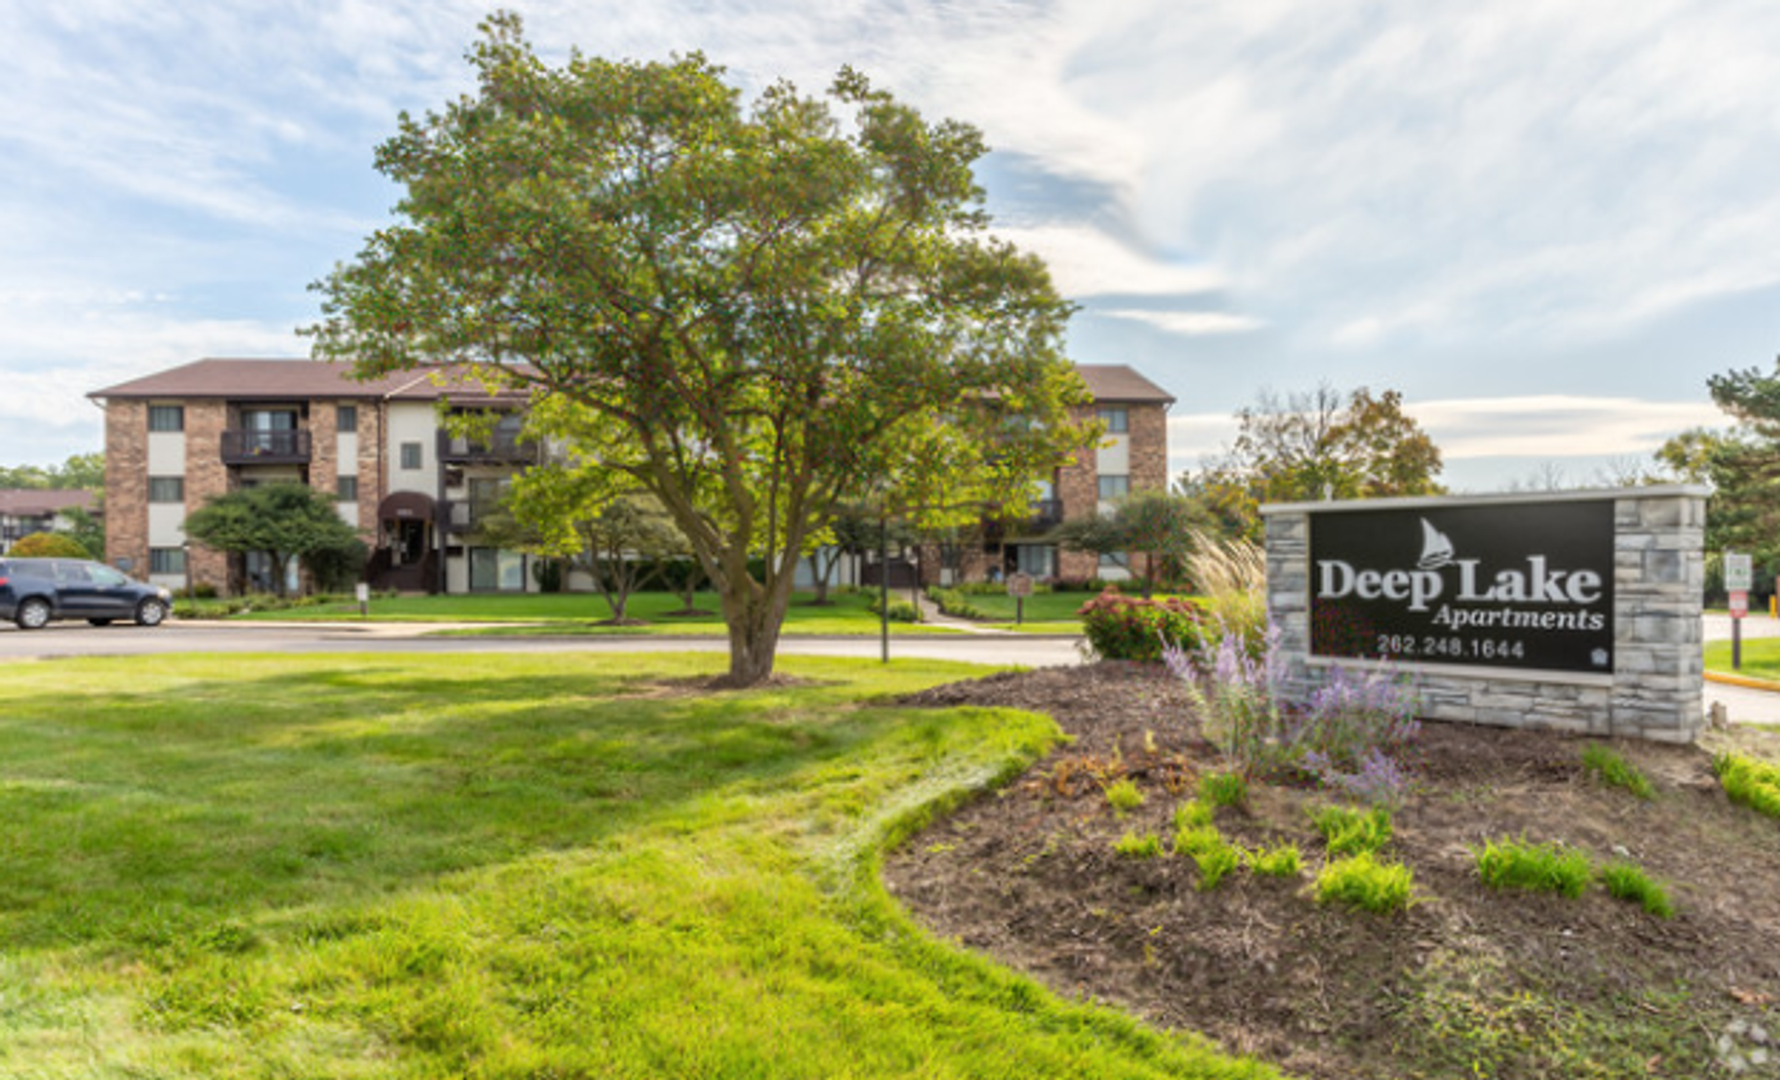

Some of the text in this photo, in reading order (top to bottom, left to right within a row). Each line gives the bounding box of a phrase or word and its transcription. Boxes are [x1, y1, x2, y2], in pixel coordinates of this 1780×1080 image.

[1318, 555, 1602, 611] Deep Lake
[1432, 605, 1604, 630] Apartments
